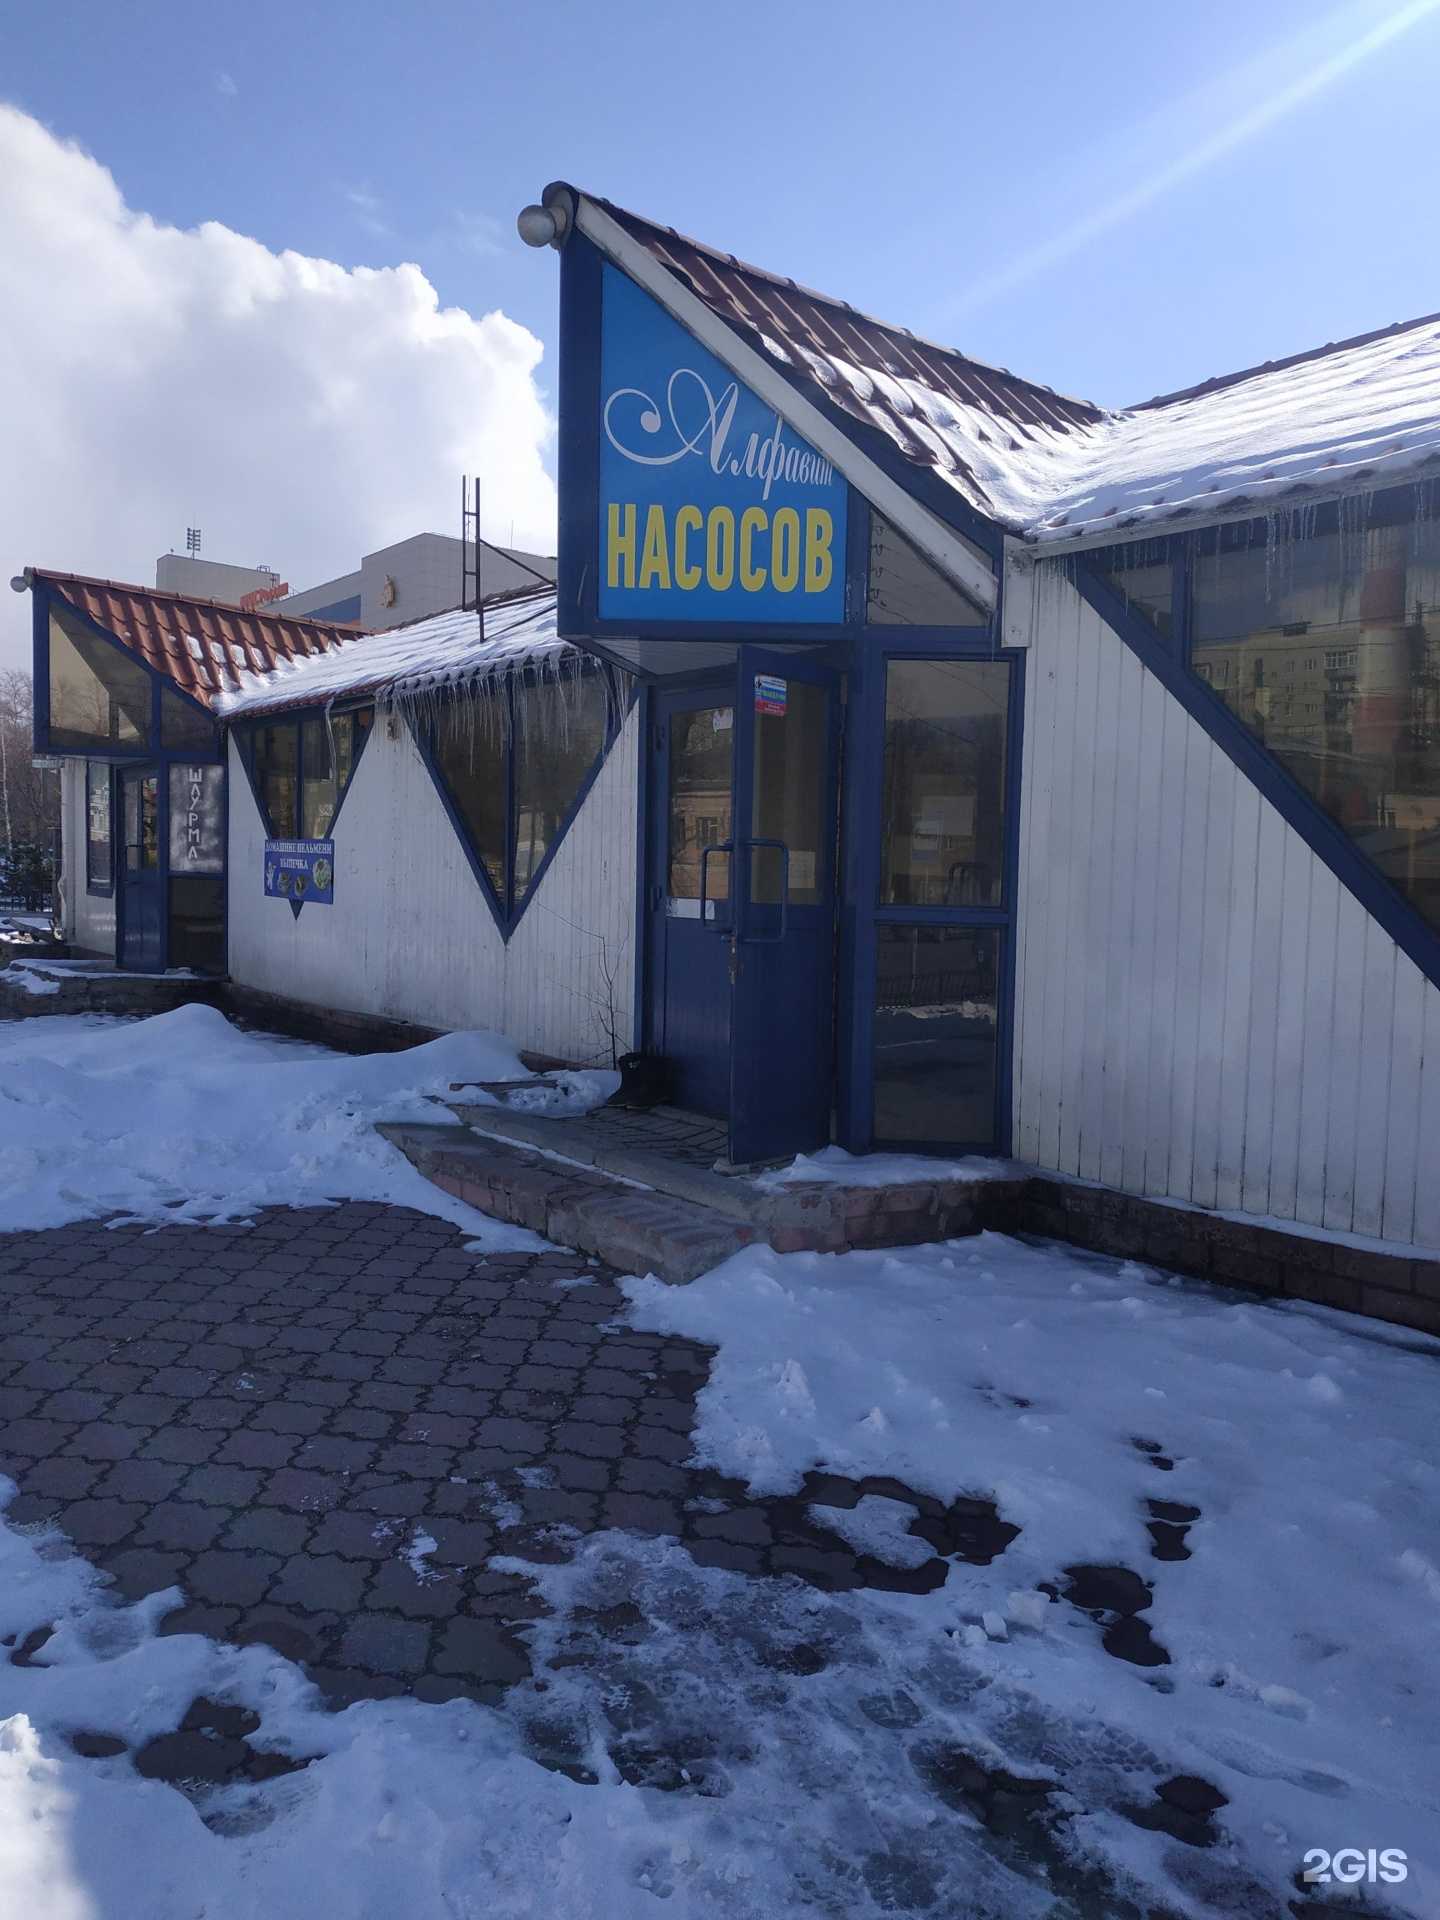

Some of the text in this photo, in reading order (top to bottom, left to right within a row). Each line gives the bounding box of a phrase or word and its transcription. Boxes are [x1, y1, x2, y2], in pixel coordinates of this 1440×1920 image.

[604, 368, 833, 500] Алфавит
[607, 503, 833, 593] НАСОСОВ
[188, 767, 202, 860] ШАУРМА
[297, 843, 332, 855] ПЕЛЬМЕНИ
